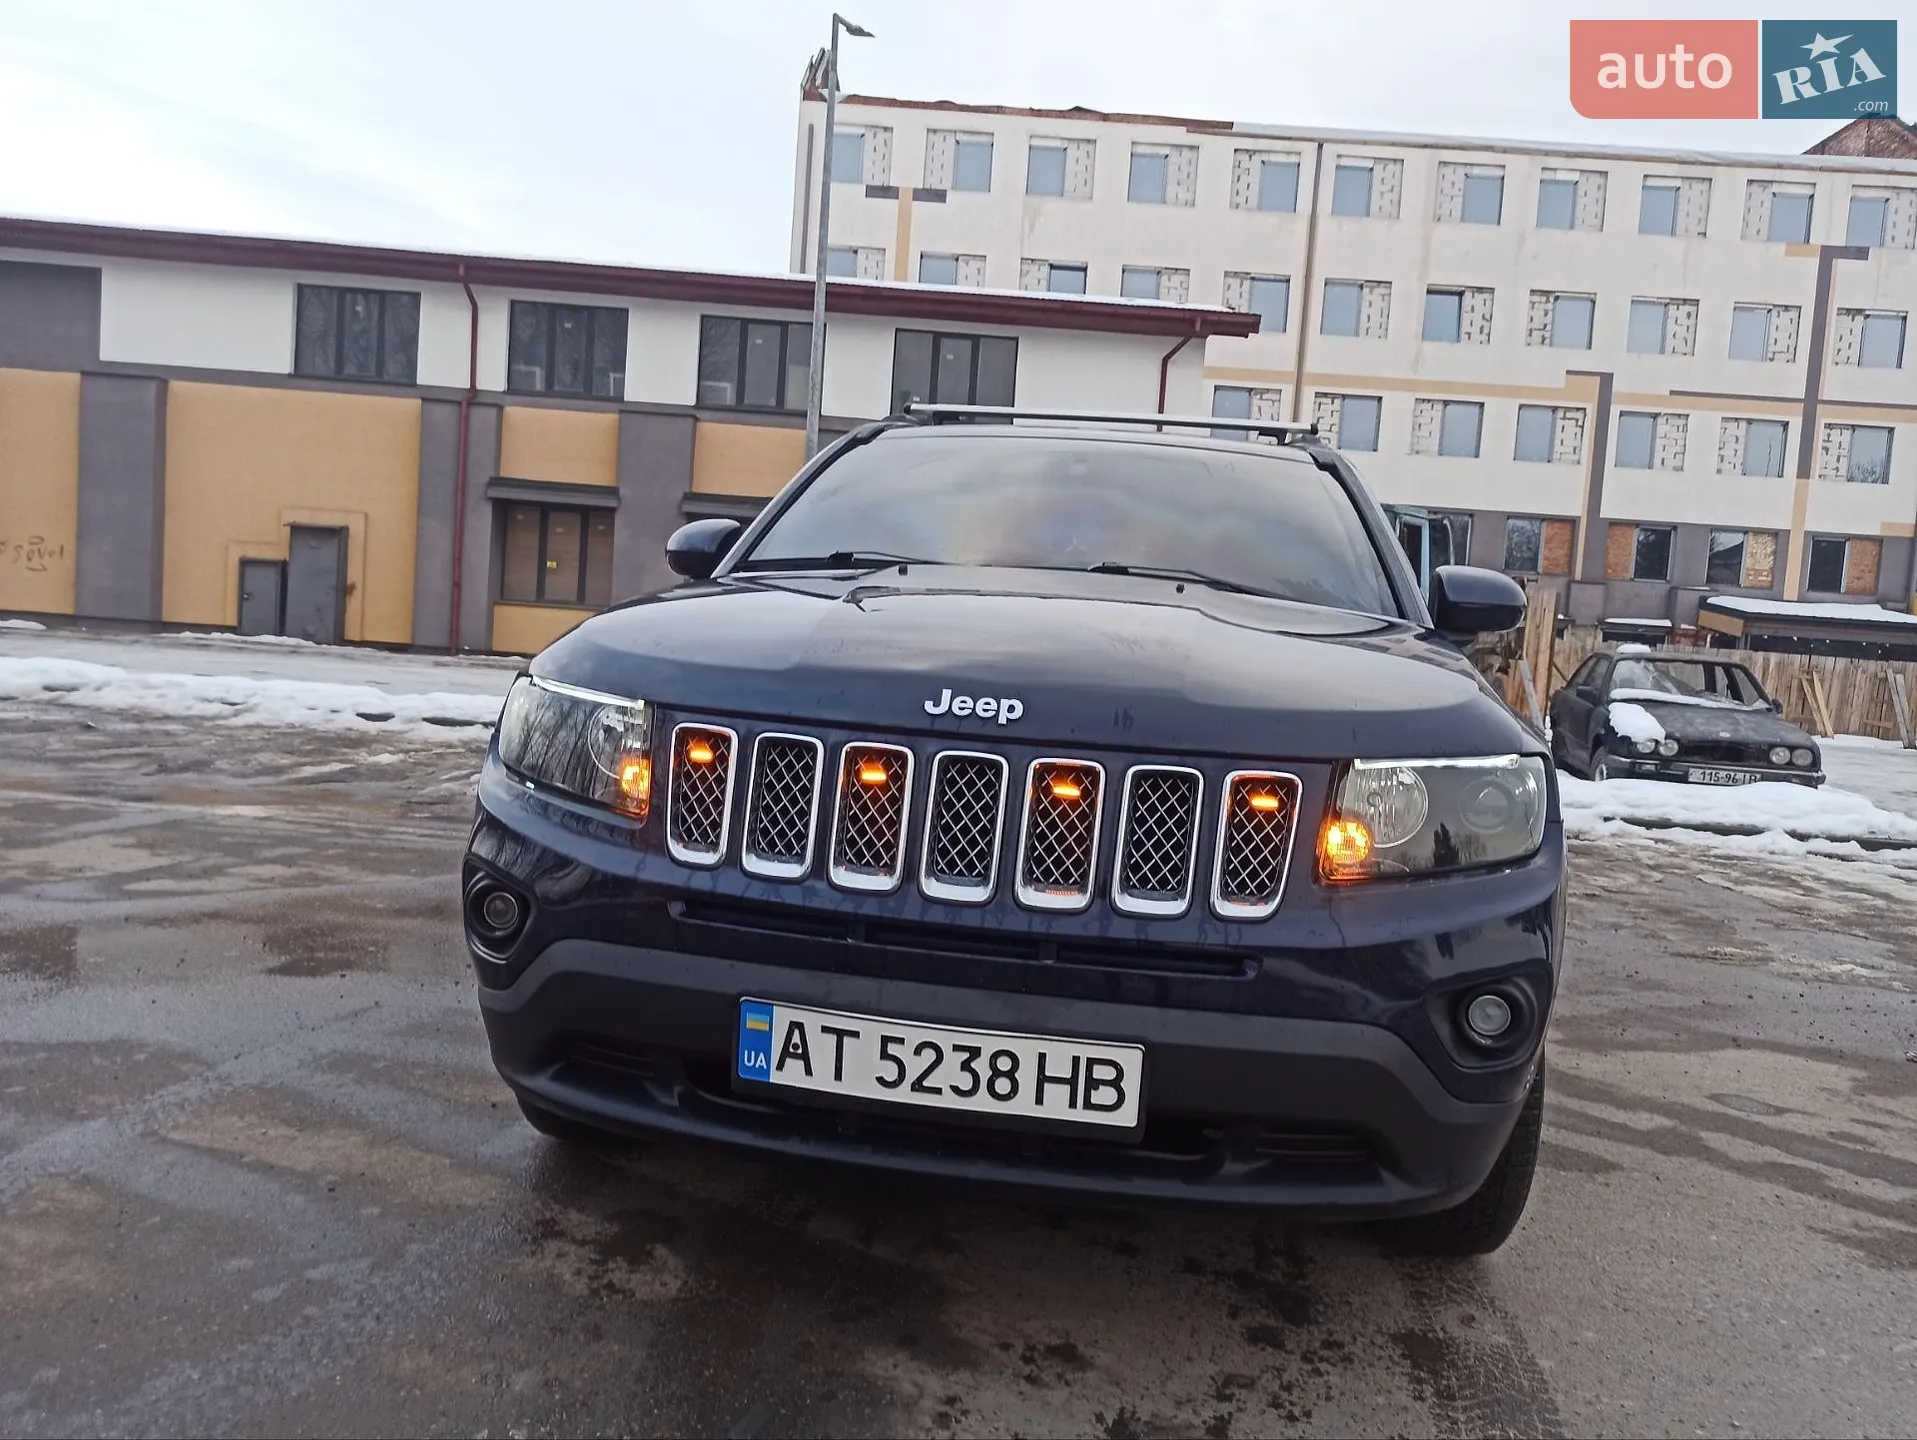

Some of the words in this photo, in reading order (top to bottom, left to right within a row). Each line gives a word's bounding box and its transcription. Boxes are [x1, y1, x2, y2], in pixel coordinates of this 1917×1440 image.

[924, 688, 1024, 725] Jeep
[743, 1049, 767, 1071] UA
[775, 1020, 861, 1082] AT
[875, 1034, 1021, 1102] 5238
[1034, 1051, 1127, 1114] HB
